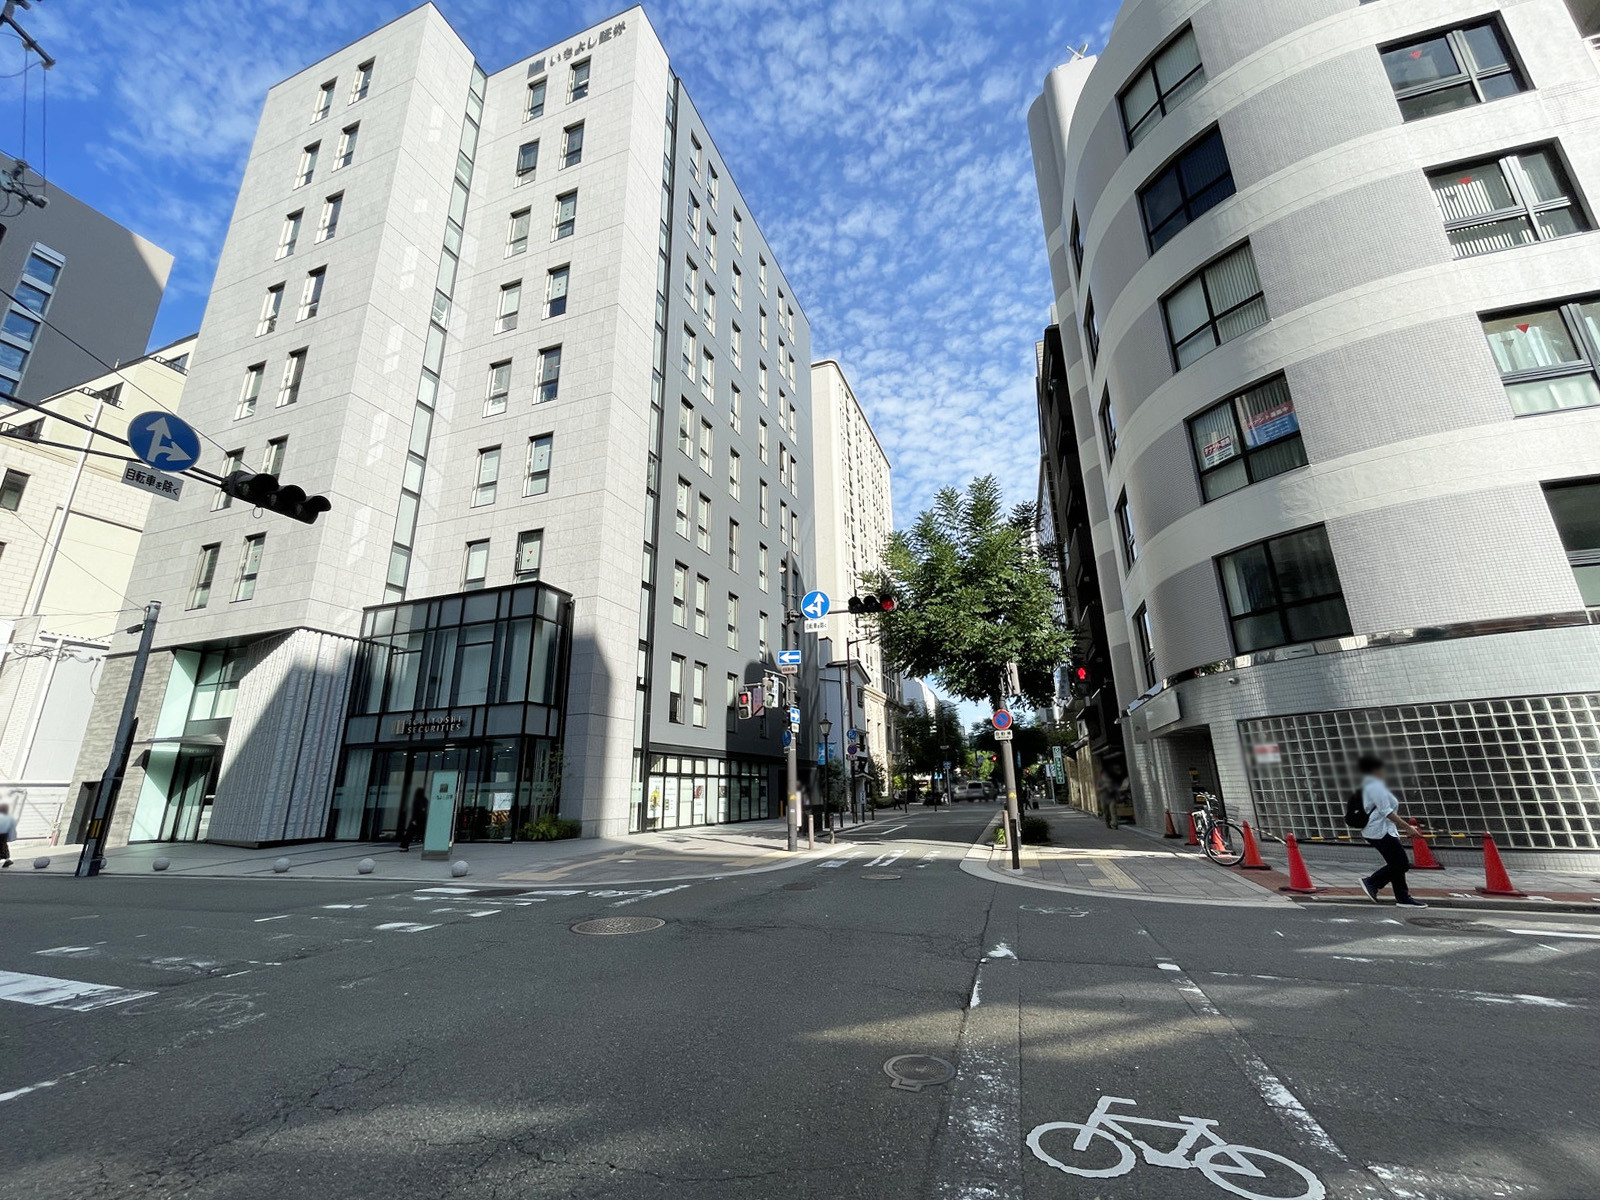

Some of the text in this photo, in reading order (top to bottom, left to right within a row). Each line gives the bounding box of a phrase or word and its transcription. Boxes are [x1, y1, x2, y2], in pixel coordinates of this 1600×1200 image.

[549, 20, 626, 67] いちよし証券
[125, 467, 179, 496] 自転車を除く
[407, 723, 461, 734] SECURITIES
